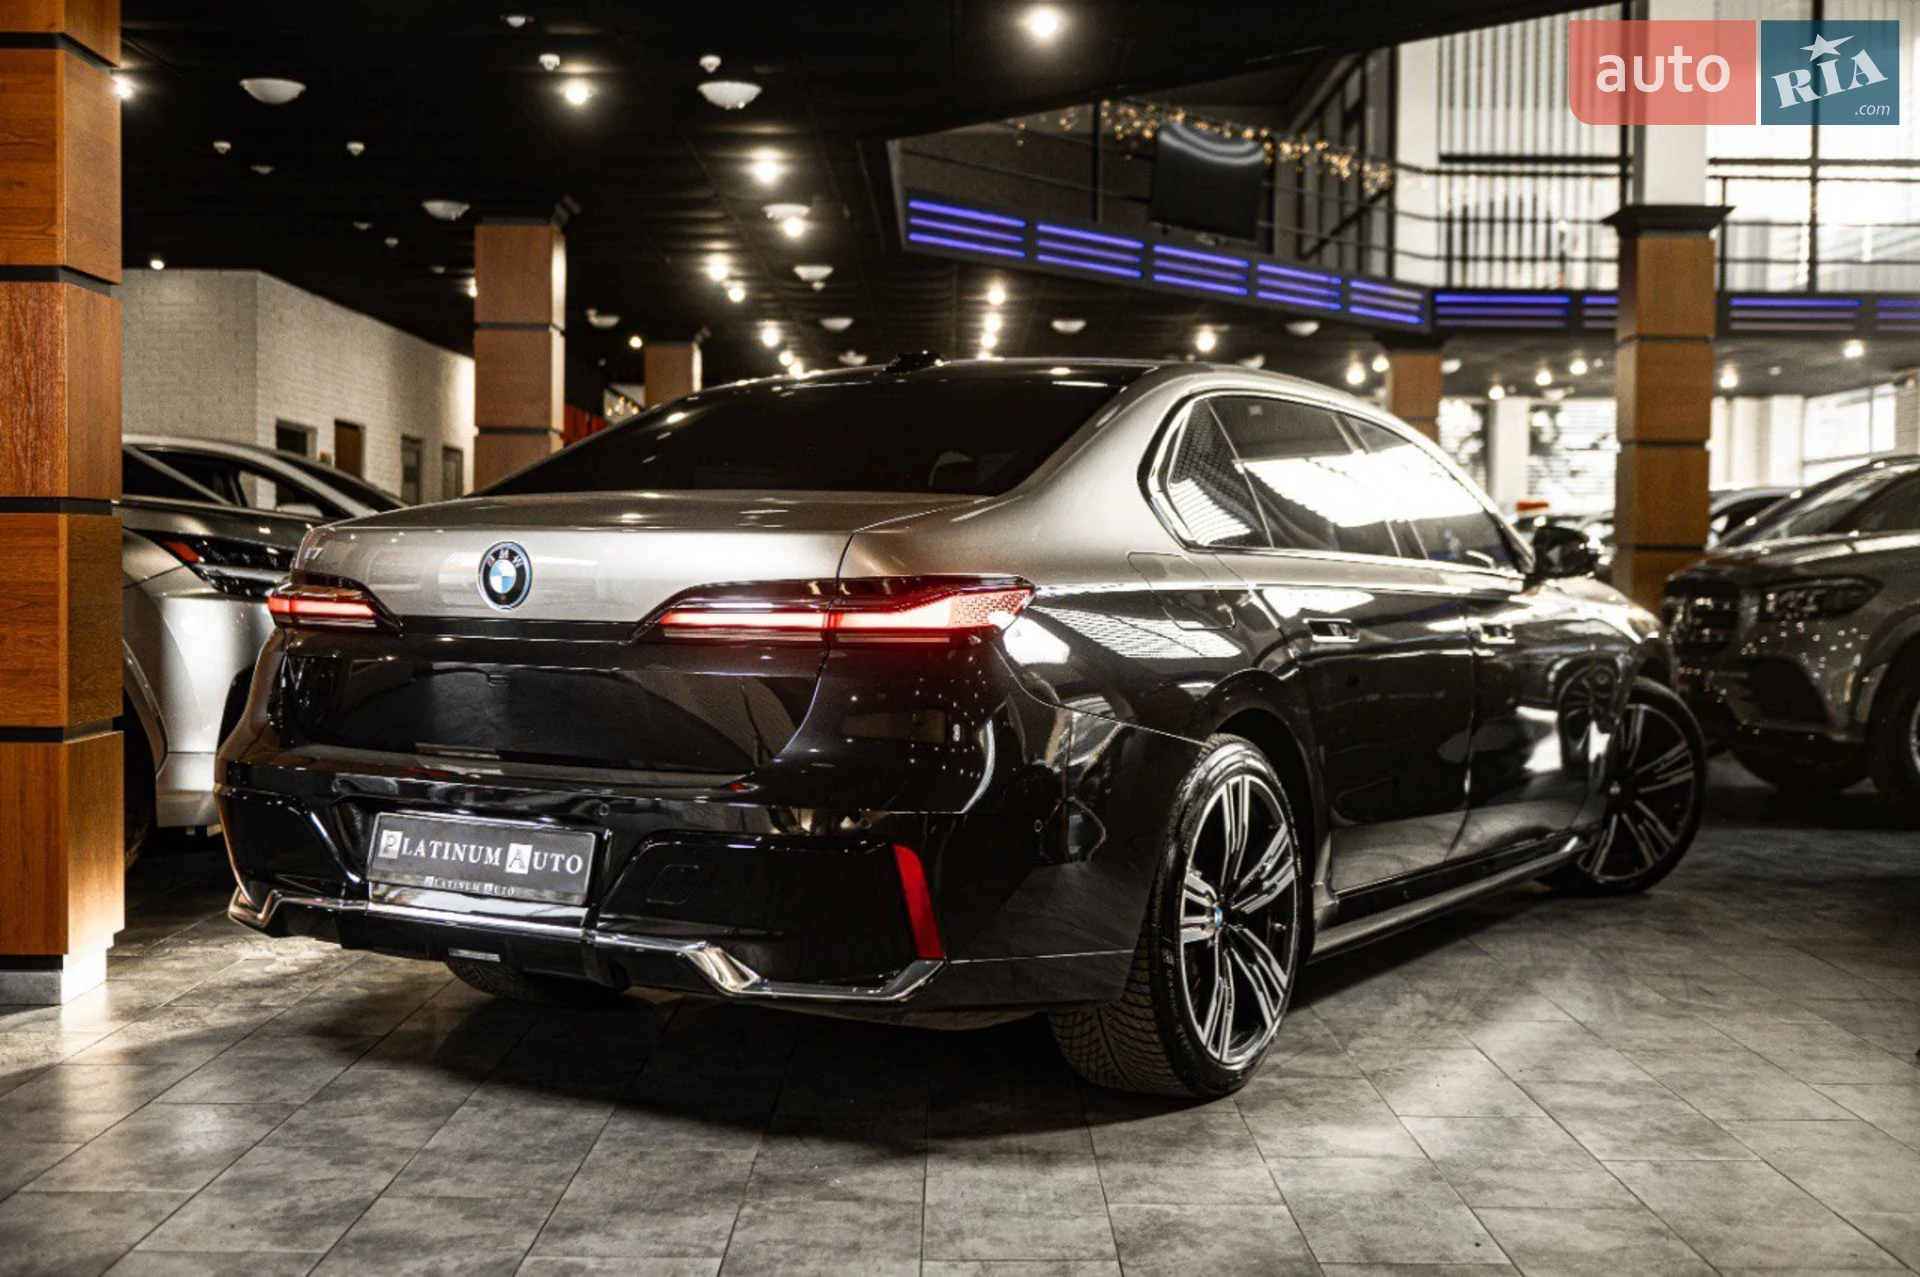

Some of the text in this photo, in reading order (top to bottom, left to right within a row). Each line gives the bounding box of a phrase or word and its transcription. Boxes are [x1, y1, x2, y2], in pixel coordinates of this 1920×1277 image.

[487, 548, 524, 568] BMW
[378, 829, 584, 875] PLATINUM AUTO
